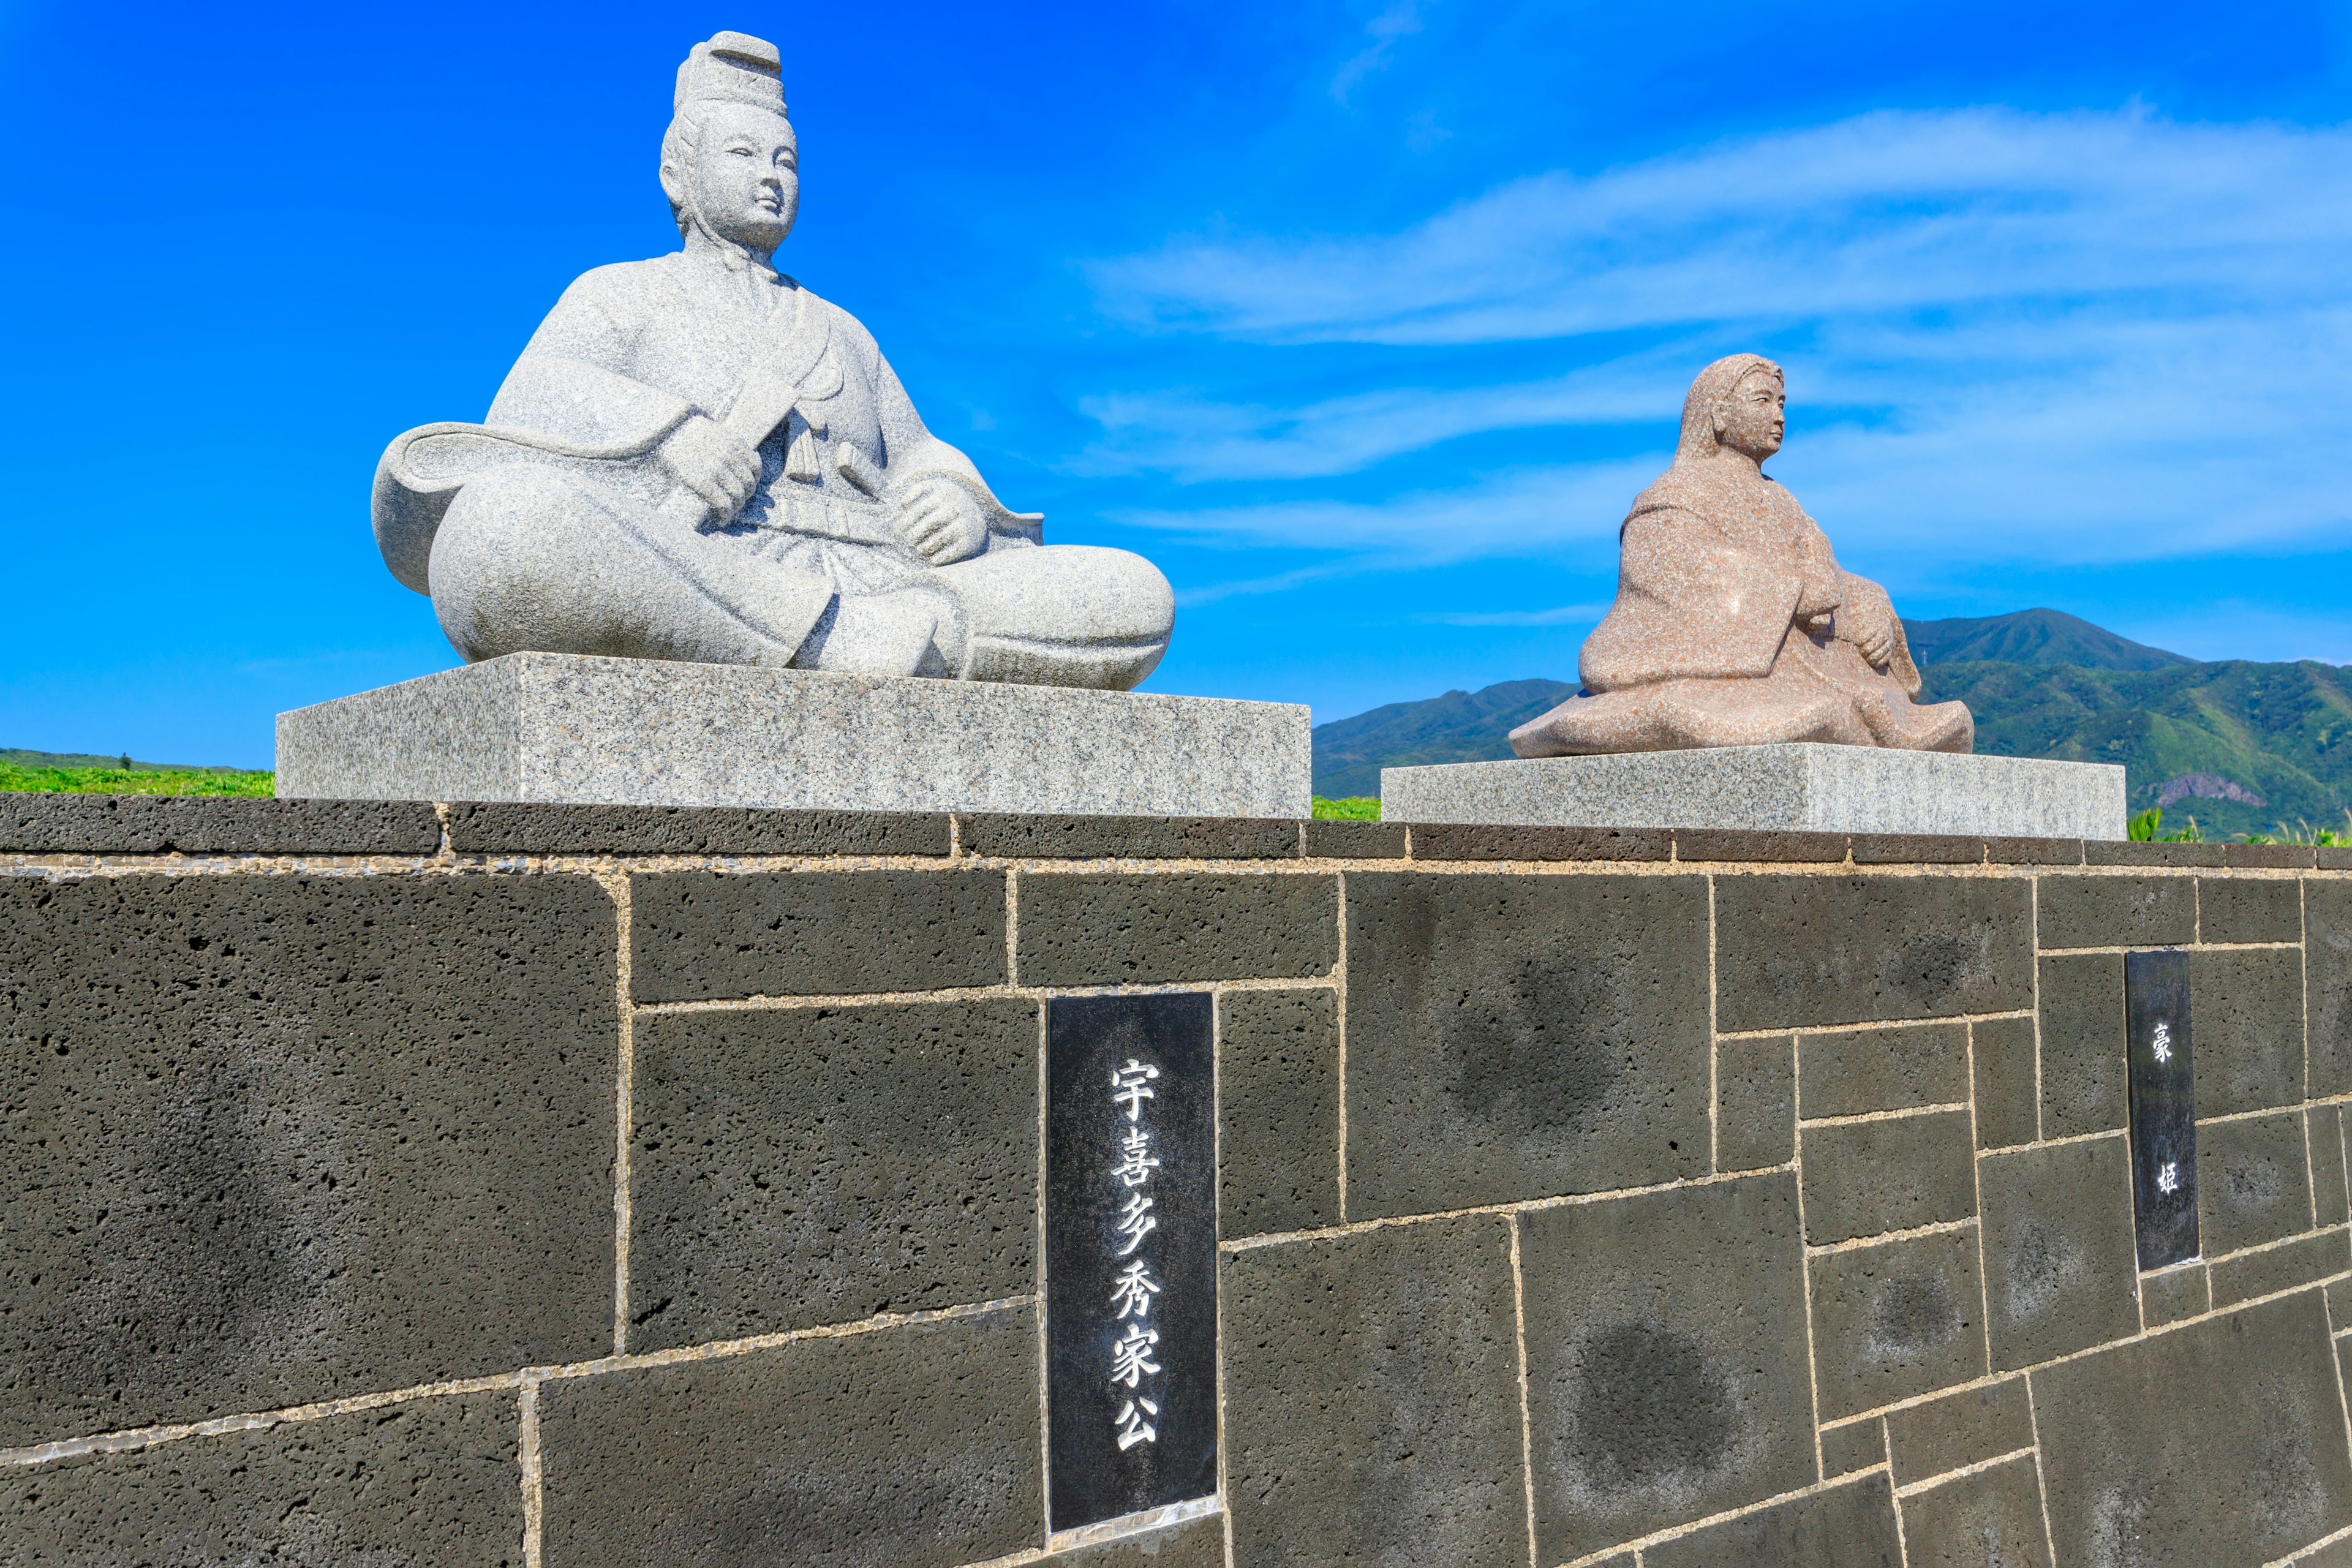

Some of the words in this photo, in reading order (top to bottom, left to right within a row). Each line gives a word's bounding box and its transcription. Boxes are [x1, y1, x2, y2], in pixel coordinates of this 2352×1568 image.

[1109, 1058, 1161, 1451] 宇喜多秀家公
